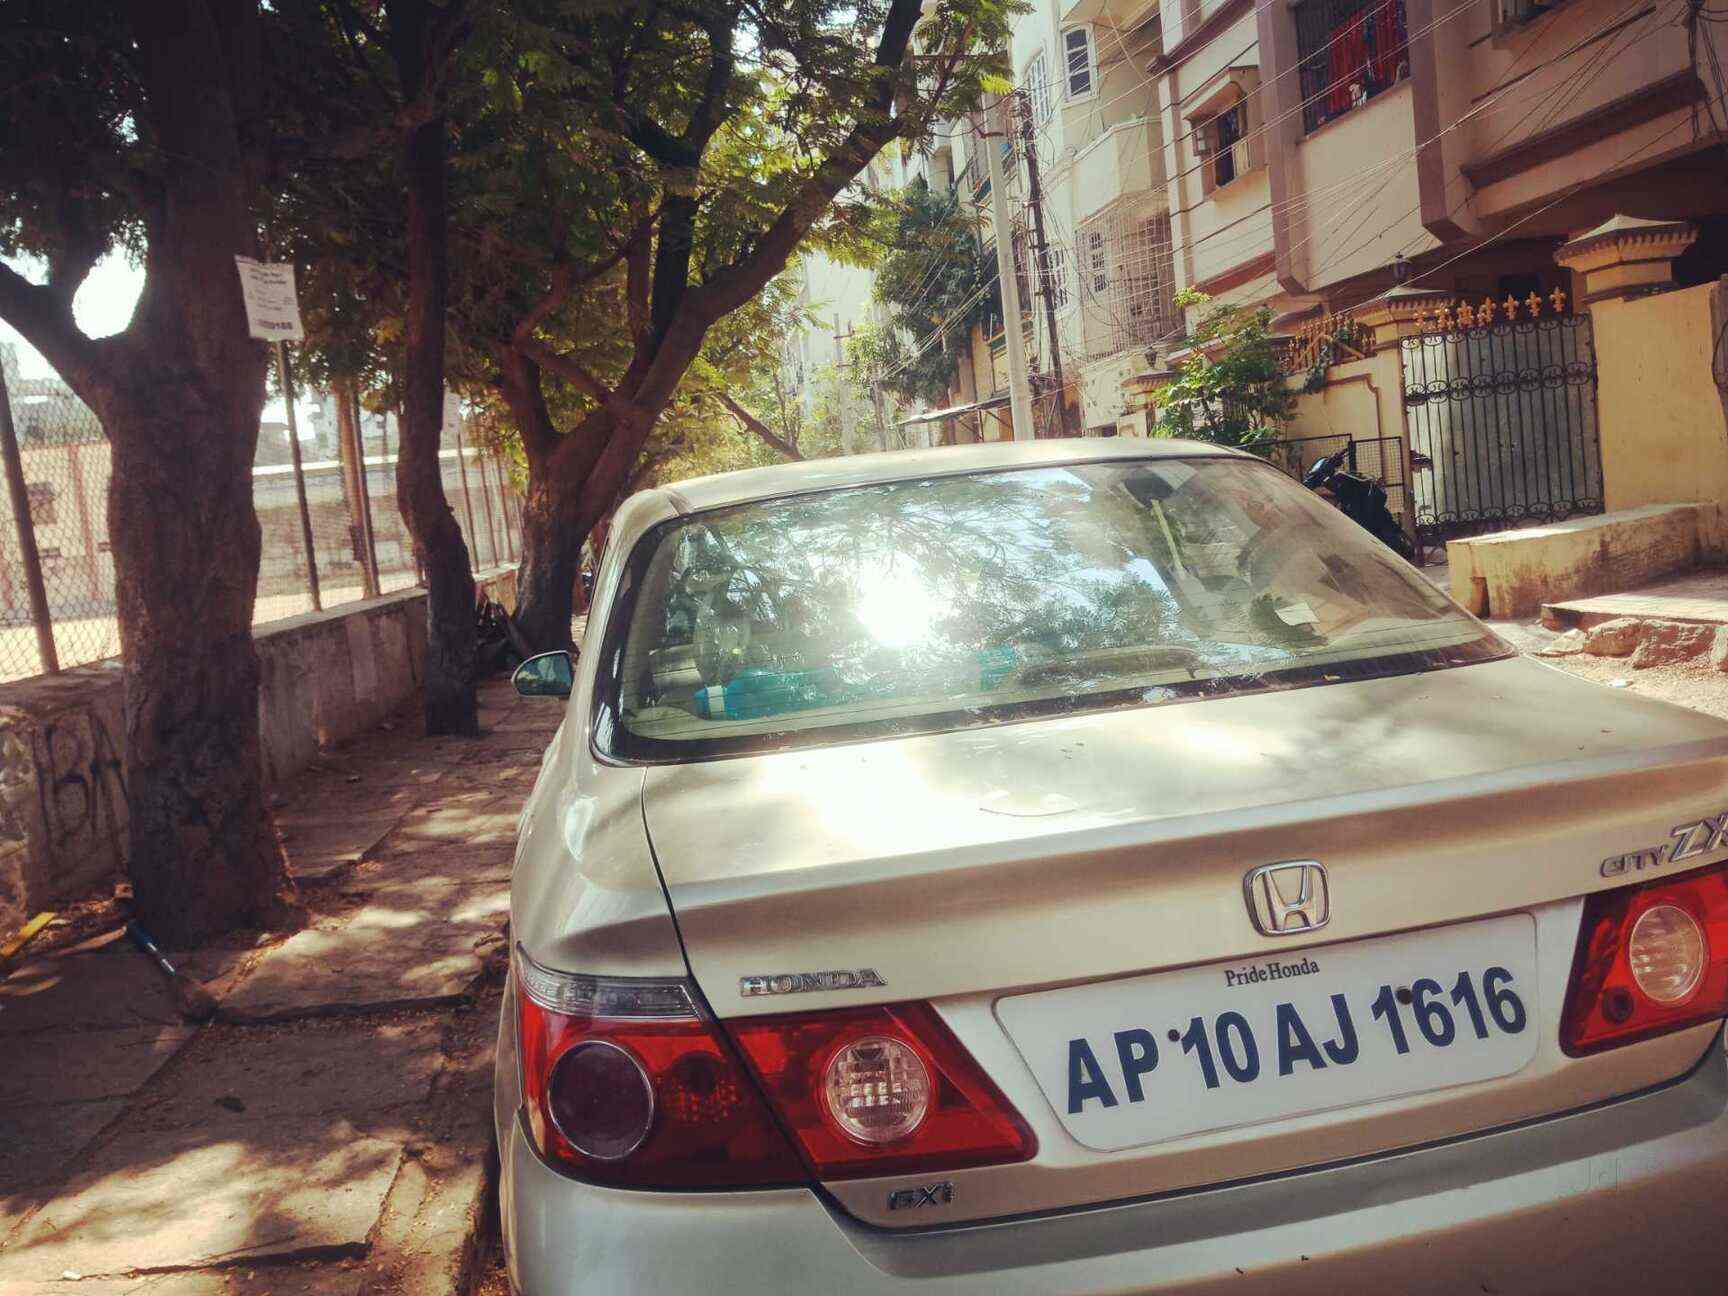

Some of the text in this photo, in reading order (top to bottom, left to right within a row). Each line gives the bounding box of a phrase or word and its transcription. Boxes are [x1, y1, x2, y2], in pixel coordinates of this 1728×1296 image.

[740, 968, 887, 997] HONDA
[1224, 957, 1320, 987] Pride Honda
[1067, 965, 1527, 1114] AP 10 AJ 1616
